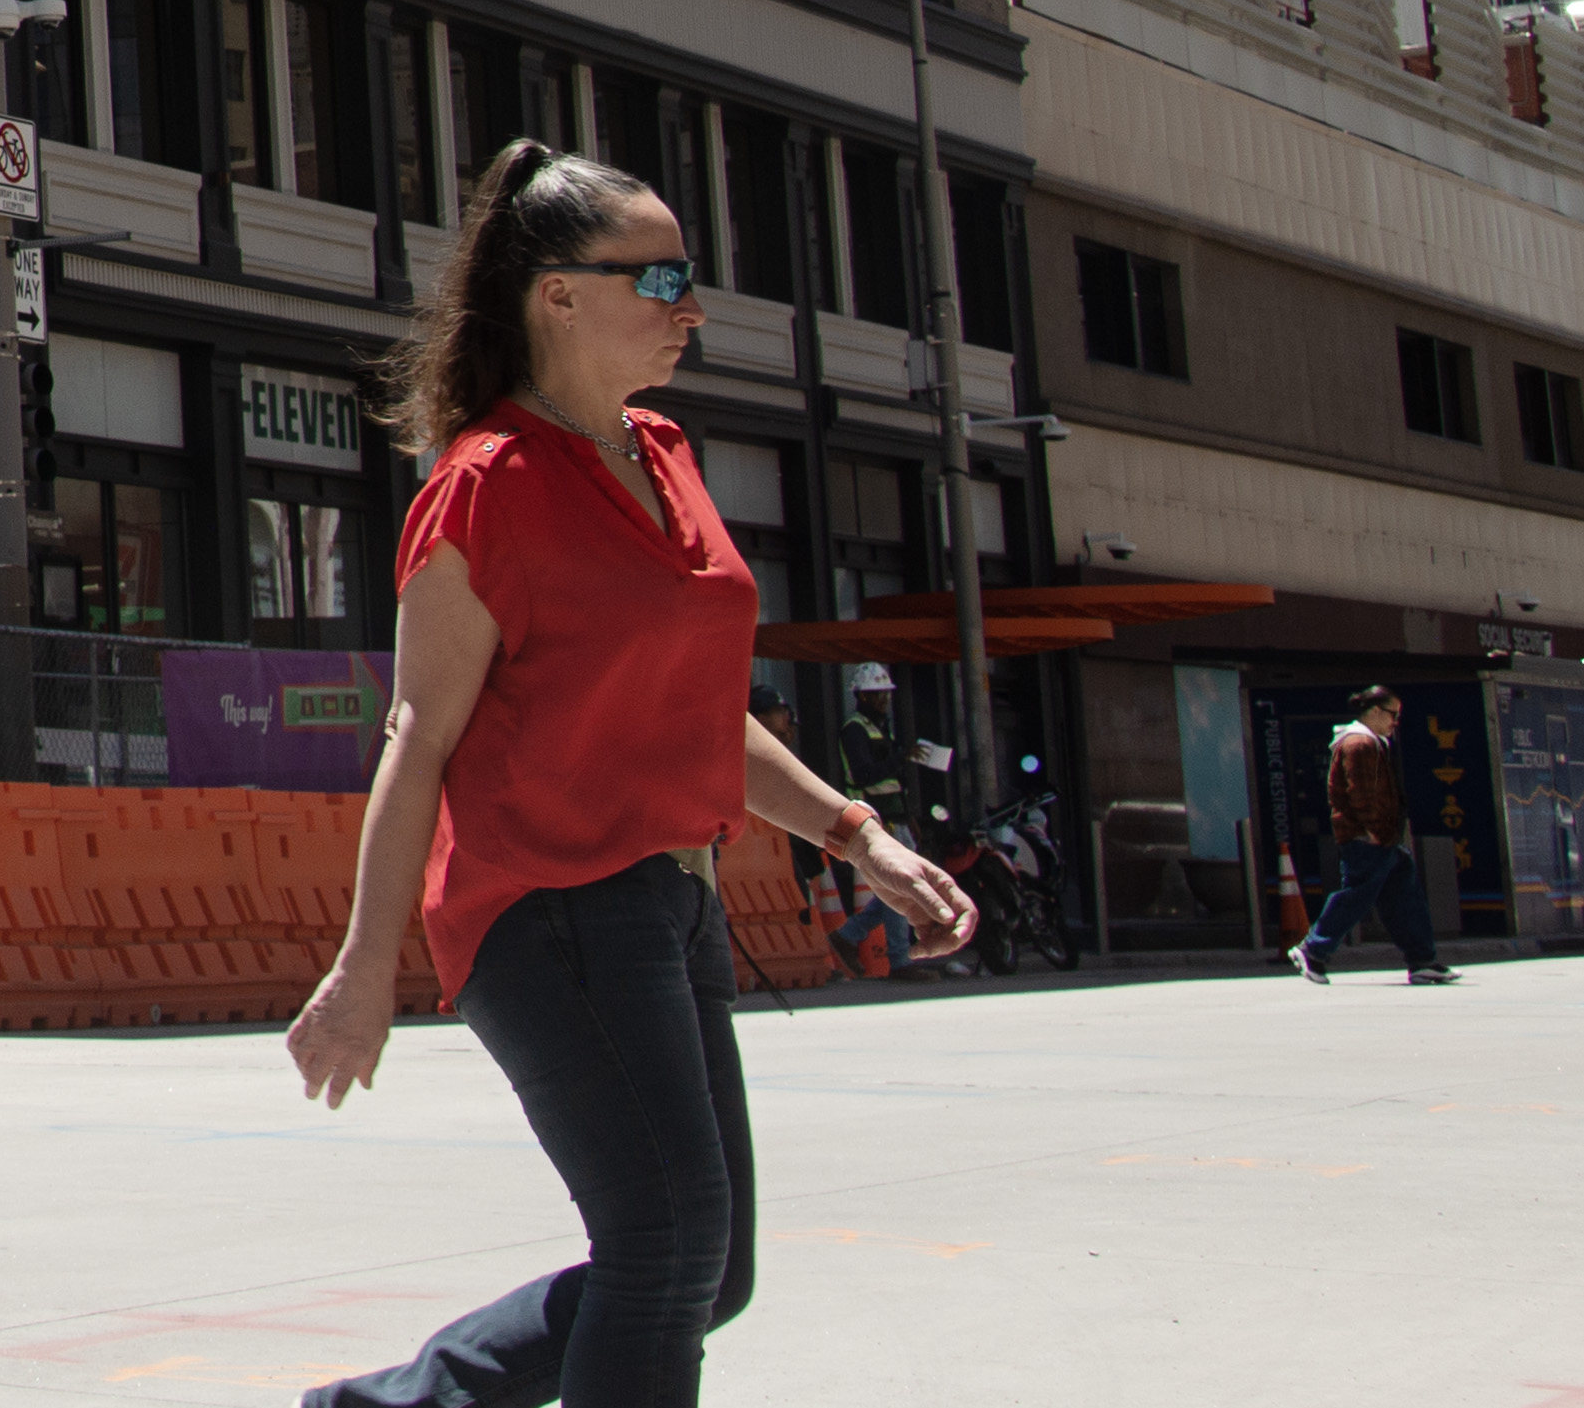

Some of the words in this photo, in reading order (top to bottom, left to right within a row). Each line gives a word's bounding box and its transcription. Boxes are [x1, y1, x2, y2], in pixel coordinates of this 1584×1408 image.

[14, 250, 39, 275] ONE
[14, 276, 40, 302] WAY
[220, 693, 248, 728] This
[249, 694, 273, 735] way!
[1264, 718, 1283, 768] PUBLIC
